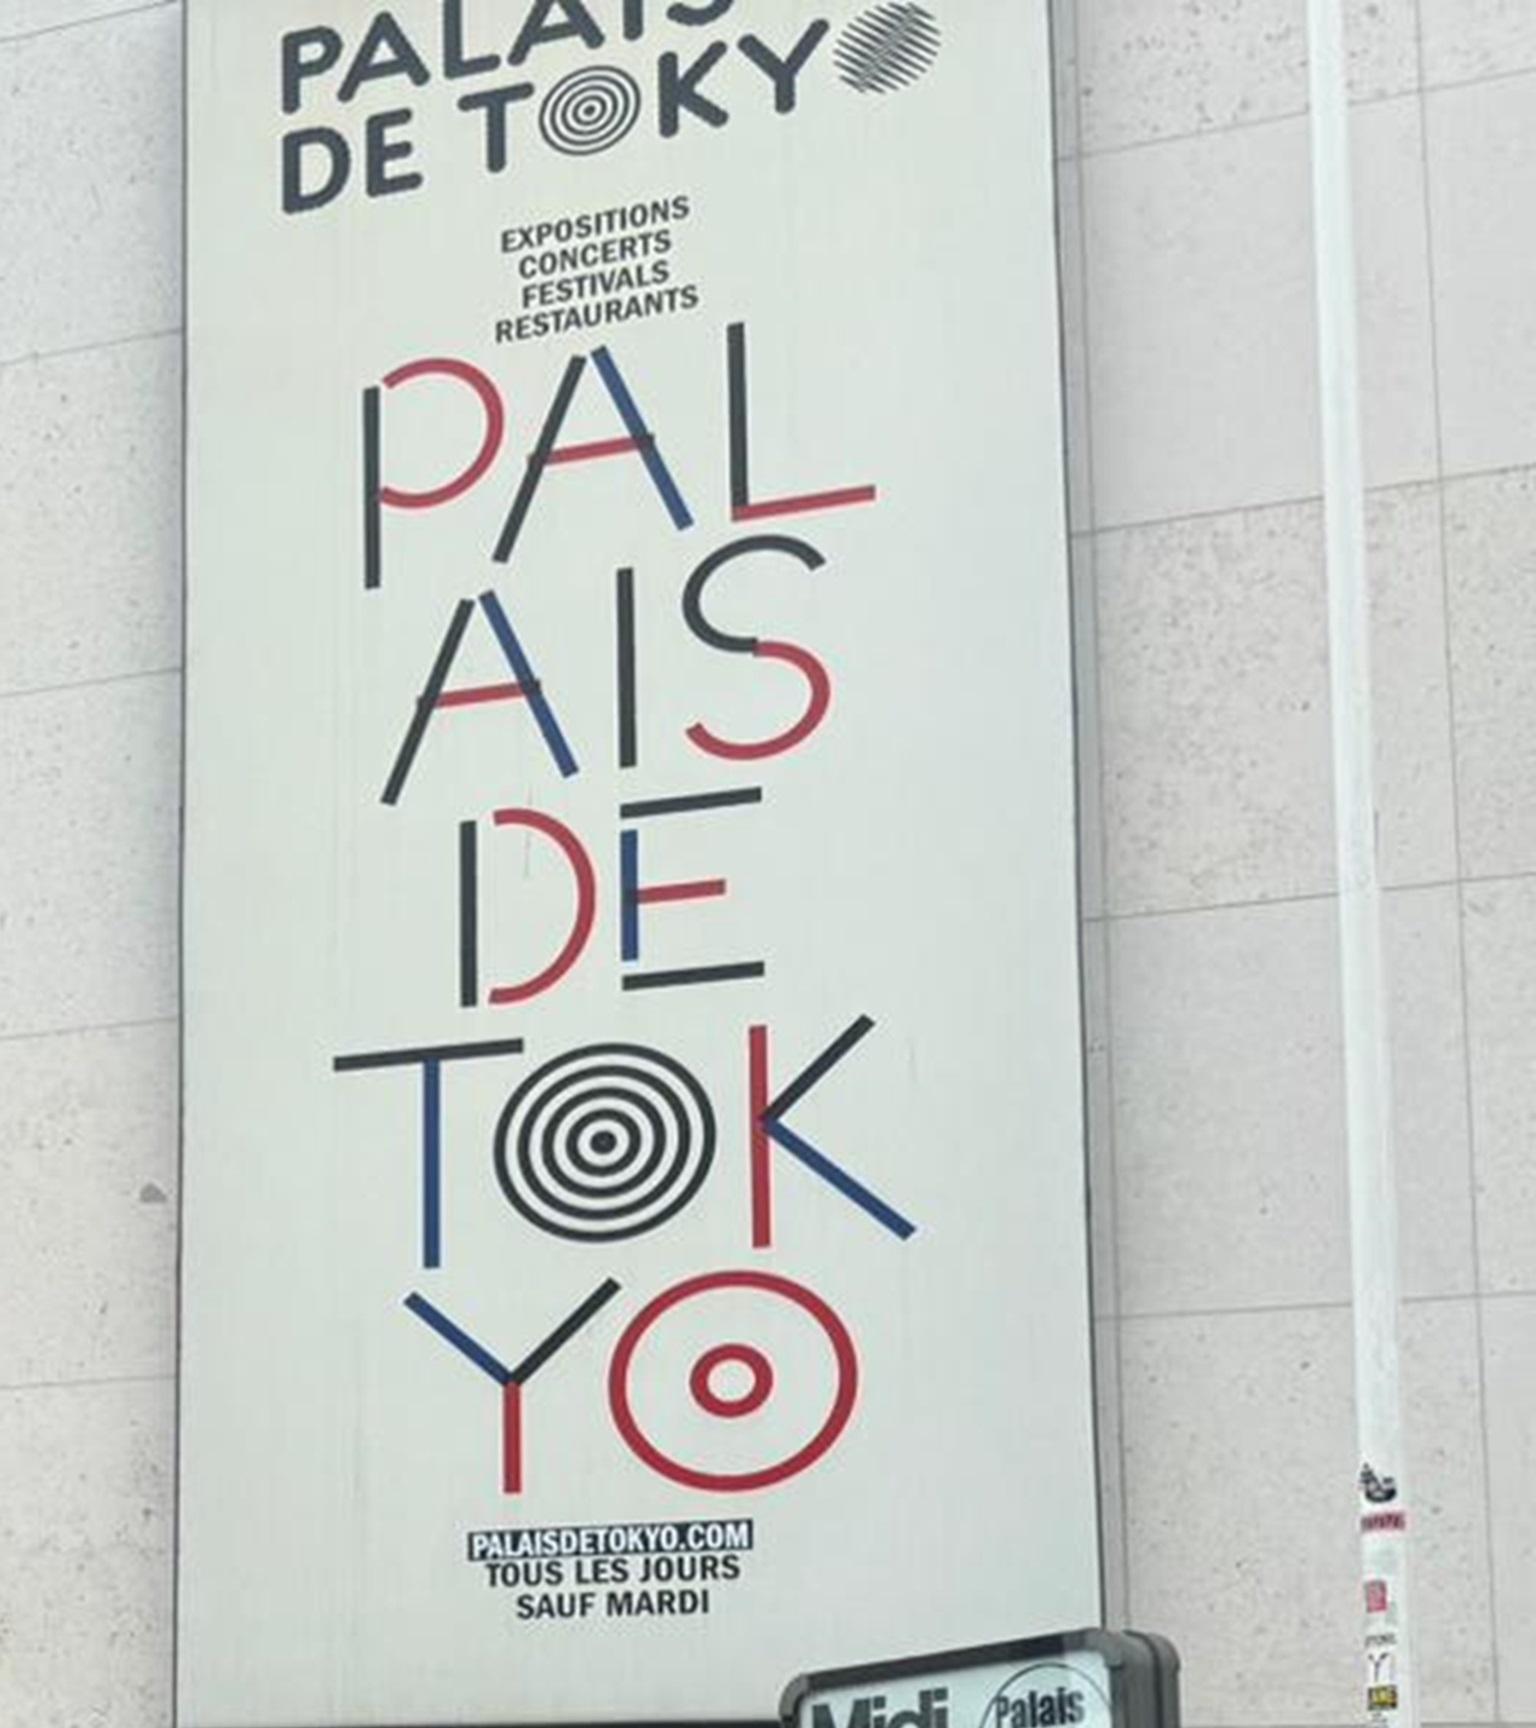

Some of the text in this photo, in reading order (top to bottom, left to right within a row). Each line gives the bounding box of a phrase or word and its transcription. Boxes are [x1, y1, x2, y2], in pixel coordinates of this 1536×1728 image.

[281, 108, 423, 215] DE
[501, 196, 691, 253] EXPOSITIONS
[518, 229, 672, 280] CONCERTS
[494, 284, 700, 344] RESTAURANTS
[521, 260, 670, 309] FESTIVALS
[362, 321, 877, 590] PAL
[380, 534, 831, 806] AIS
[458, 785, 766, 1008] DE
[332, 1013, 917, 1270] TOK
[402, 1269, 859, 1494] YO
[470, 1521, 752, 1559] PALAISDETOKYO.COM
[485, 1554, 741, 1588] TOUS LES JOURS
[516, 1588, 710, 1620] SAUF MARDI
